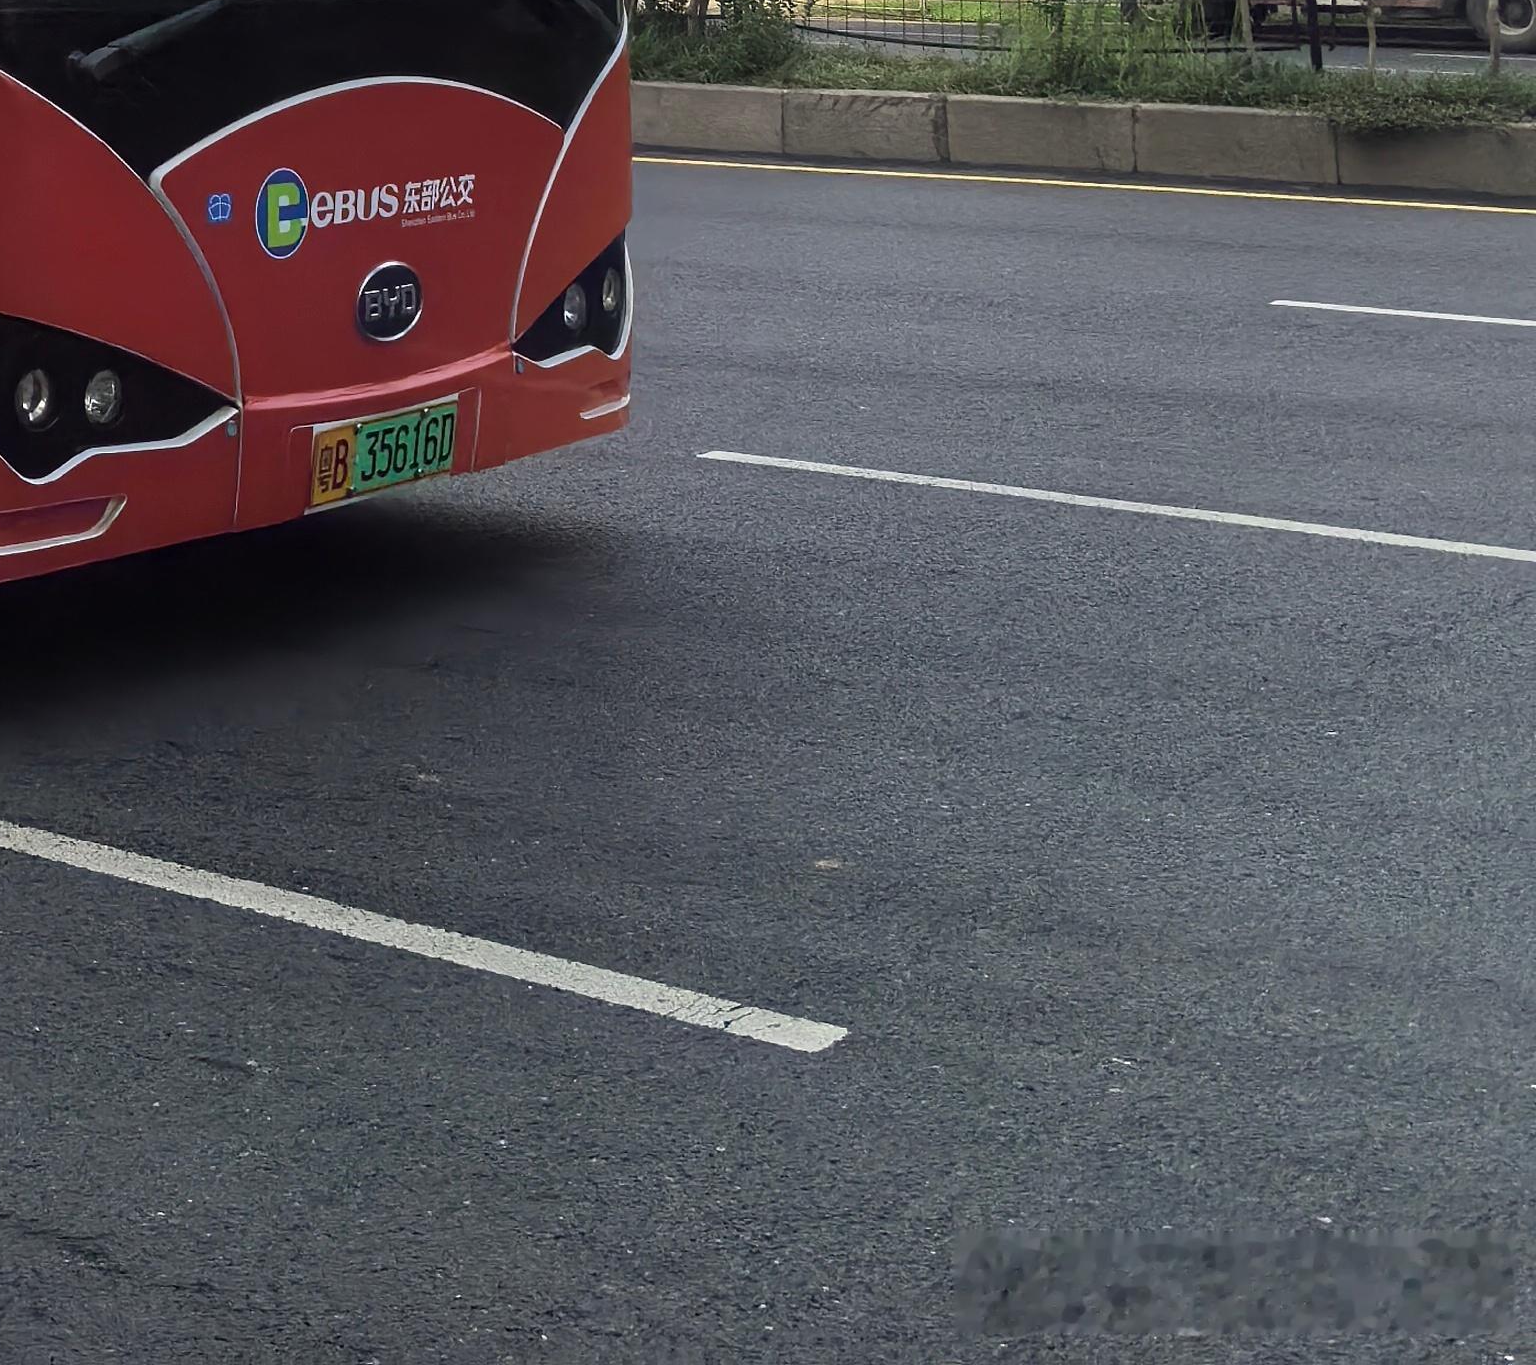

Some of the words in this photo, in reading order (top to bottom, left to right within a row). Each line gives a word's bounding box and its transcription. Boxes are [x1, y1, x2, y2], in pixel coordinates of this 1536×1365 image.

[401, 173, 476, 214] 东部公交
[364, 283, 416, 321] BYD
